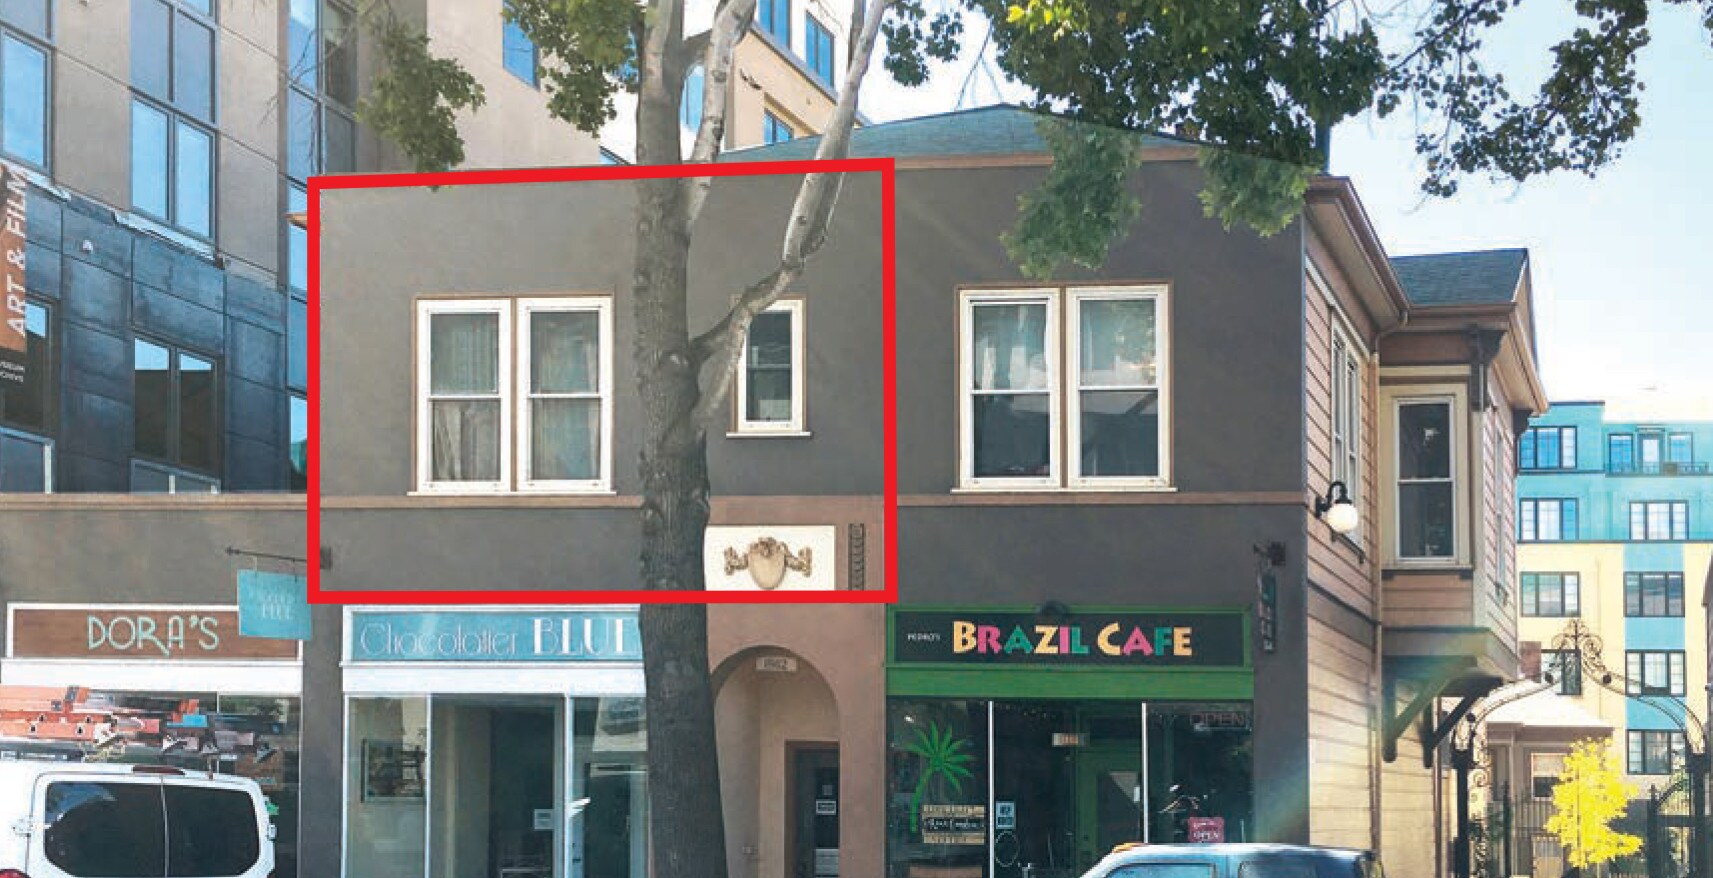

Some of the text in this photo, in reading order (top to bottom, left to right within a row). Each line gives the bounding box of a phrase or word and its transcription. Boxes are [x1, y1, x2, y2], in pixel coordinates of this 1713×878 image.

[6, 172, 26, 338] ART & FILM
[87, 614, 220, 656] DORA'S
[360, 617, 641, 656] Chocolatier BLUE
[953, 621, 1193, 656] BRAZIL CAFE
[1189, 712, 1245, 727] OPEN
